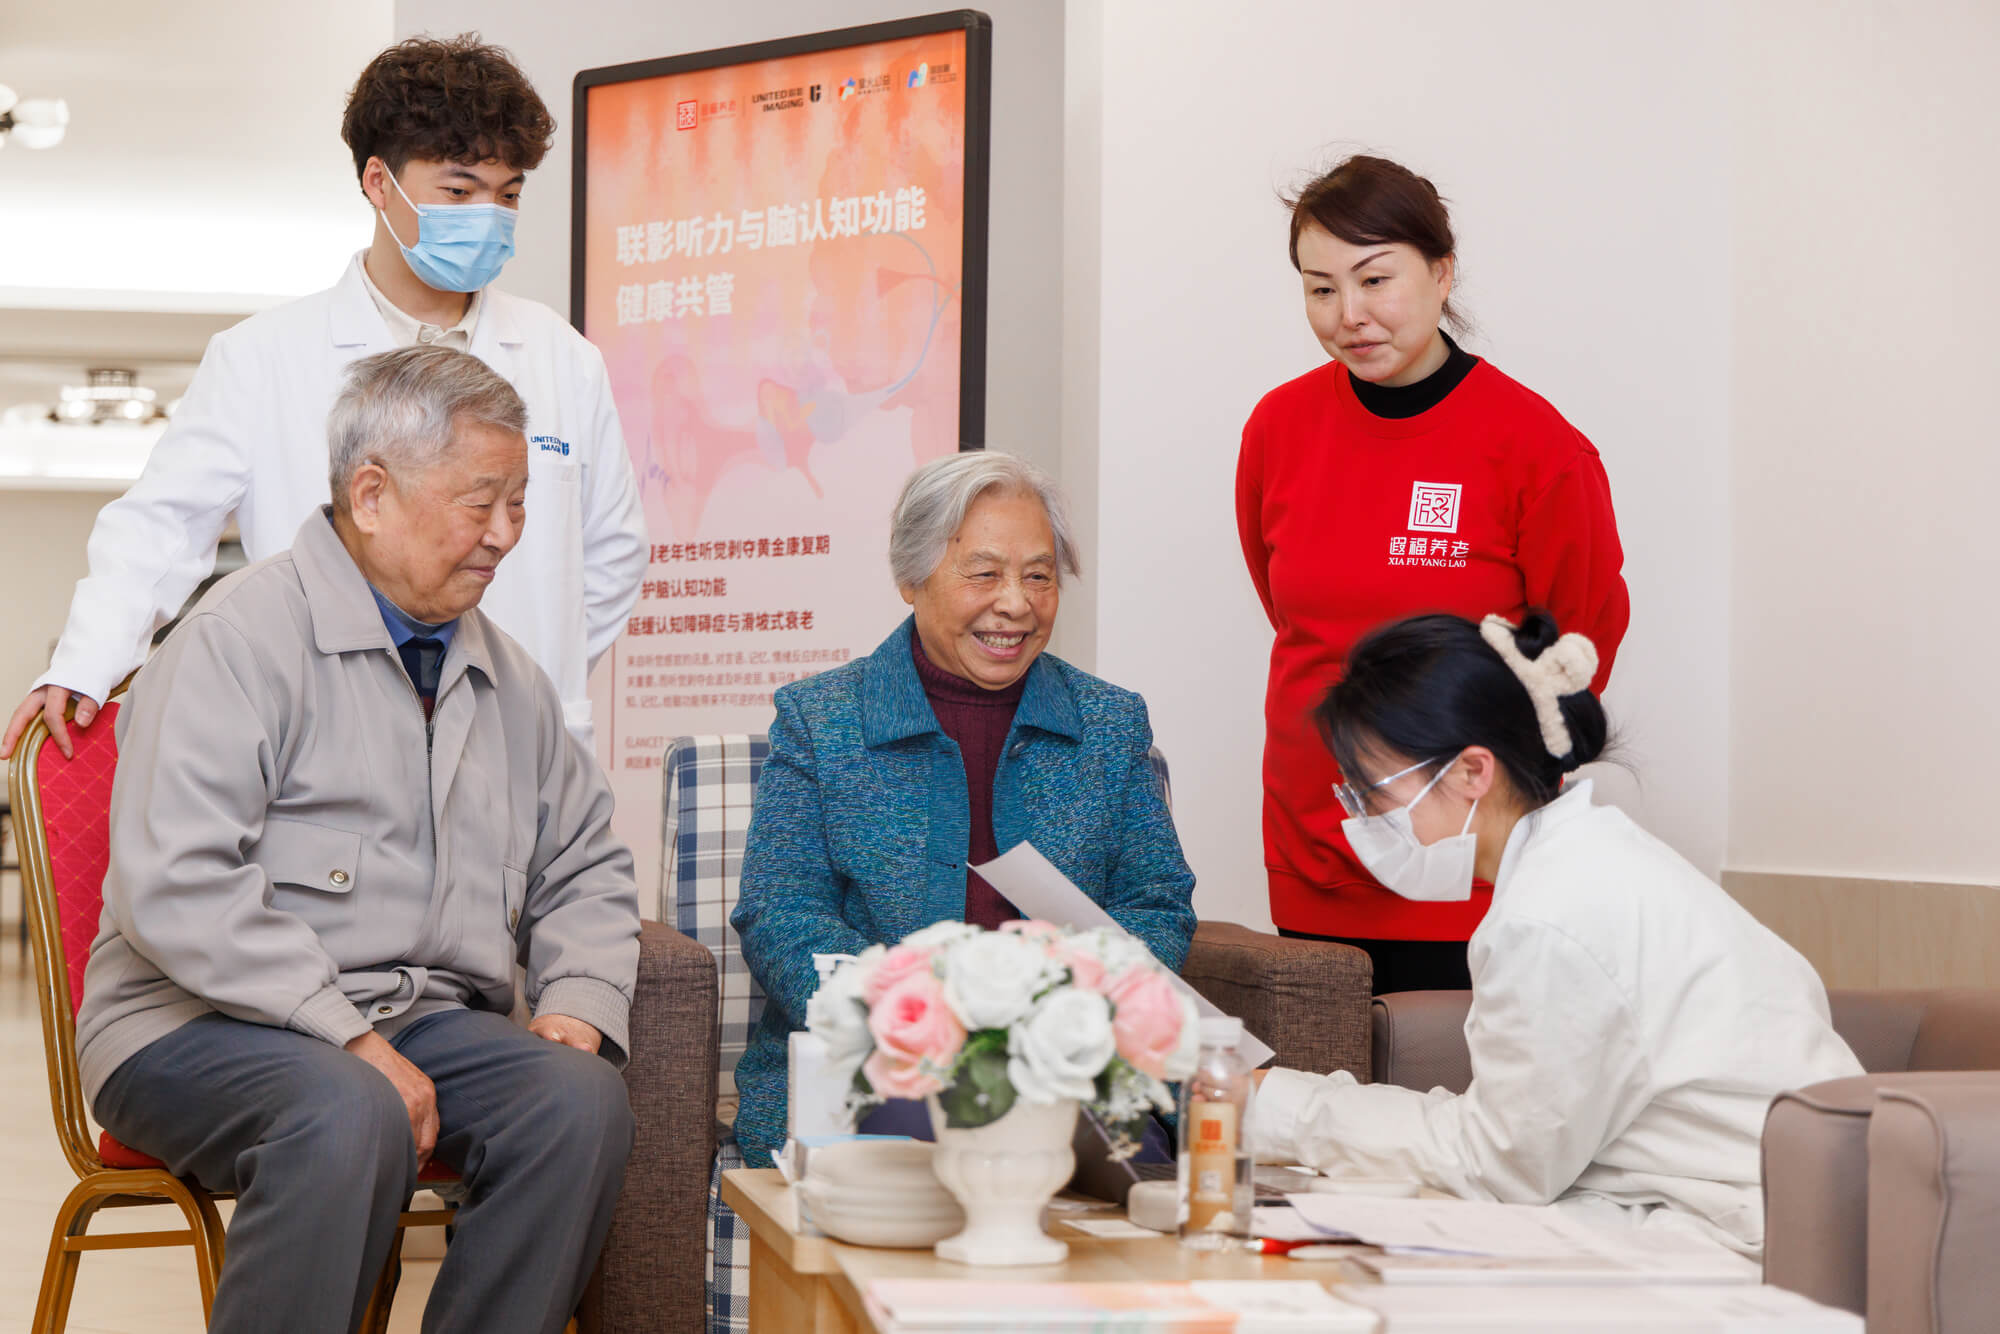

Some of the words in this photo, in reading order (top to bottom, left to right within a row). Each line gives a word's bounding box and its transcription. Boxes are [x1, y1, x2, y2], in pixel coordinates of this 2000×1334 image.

[752, 89, 787, 104] UNITED
[763, 98, 804, 113] IMAGING
[616, 186, 926, 266] 联影听力与脑认知功能
[616, 273, 735, 326] 健康共管
[1388, 557, 1405, 566] XIA
[1406, 558, 1419, 566] FU
[1420, 558, 1447, 567] YANG
[1448, 559, 1467, 568] LAO
[627, 610, 813, 636] 延缓认知障碍症与滑坡式衰老
